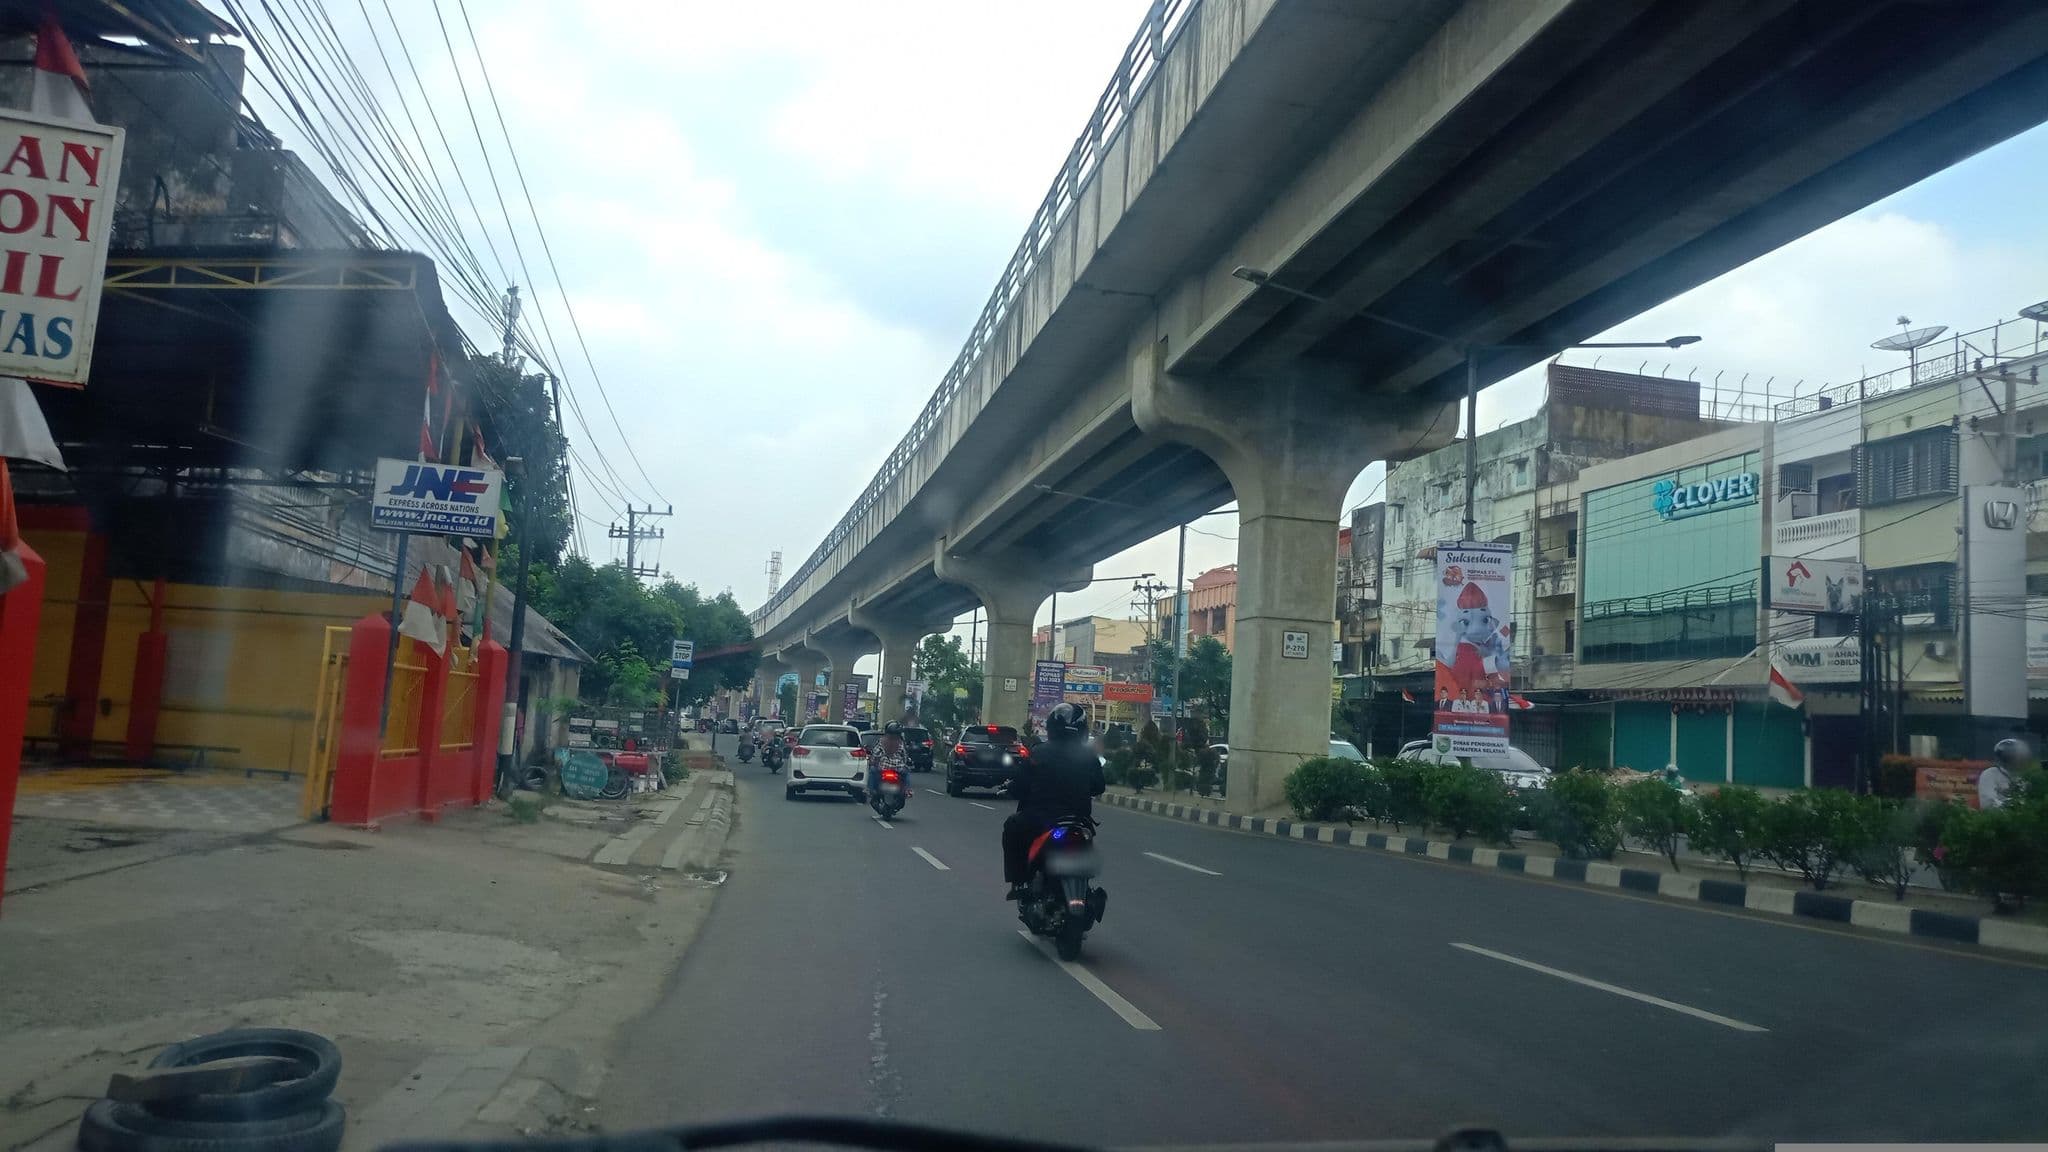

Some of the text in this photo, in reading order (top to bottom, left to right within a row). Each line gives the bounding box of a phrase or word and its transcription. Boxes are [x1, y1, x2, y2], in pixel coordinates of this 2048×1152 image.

[0, 310, 74, 360] AS
[382, 465, 489, 503] JNE
[1672, 472, 1756, 509] CLOVER
[389, 498, 479, 514] EXPRESS ACROSS NATIONS
[379, 509, 489, 526] www.jne.co.id
[1445, 552, 1502, 565] Sukseskan
[675, 651, 690, 660] STOP
